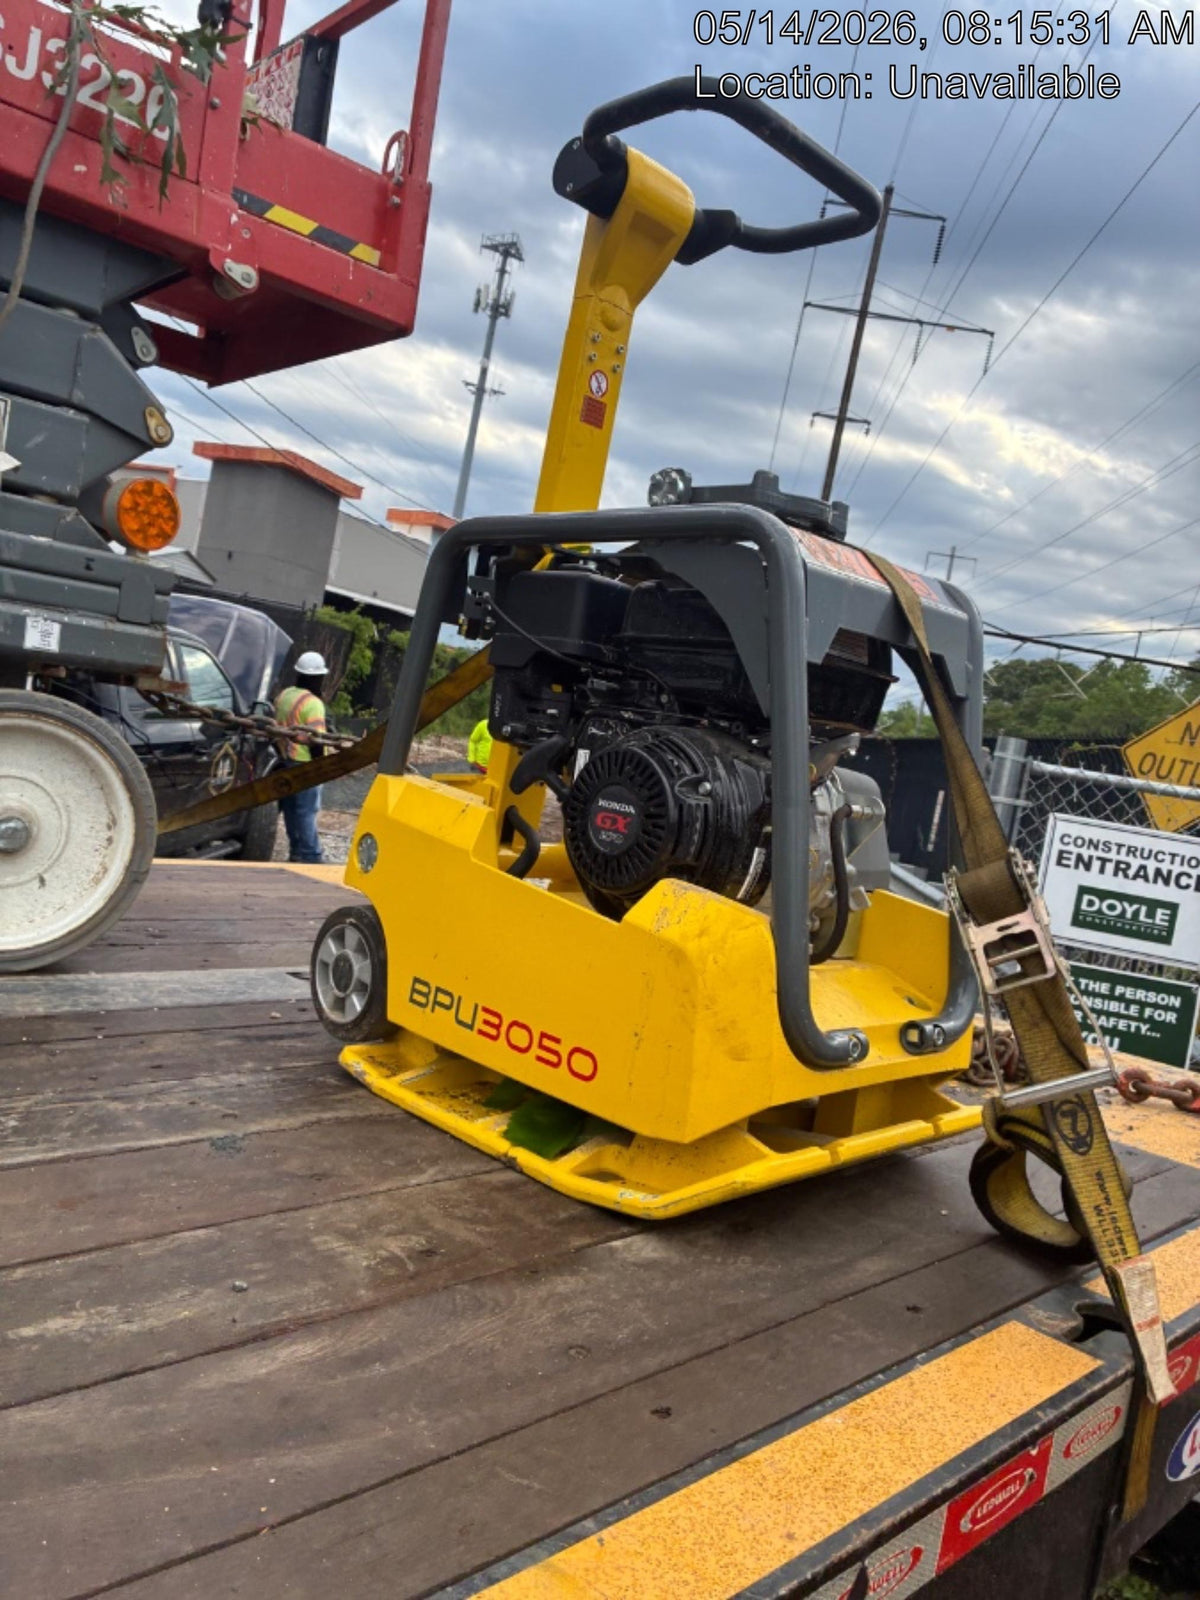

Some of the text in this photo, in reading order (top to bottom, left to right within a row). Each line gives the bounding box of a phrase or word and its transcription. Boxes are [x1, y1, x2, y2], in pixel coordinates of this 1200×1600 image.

[1179, 721, 1200, 746] N
[1137, 751, 1200, 786] OUTL
[597, 798, 636, 815] HONDA
[596, 811, 633, 835] GX
[1059, 833, 1200, 869] CONSTRUCTIO
[1055, 849, 1200, 892] ENTRANC
[1080, 894, 1172, 926] DOYLE
[1078, 977, 1111, 995] THE
[1114, 985, 1181, 1008] PERSON
[1070, 994, 1141, 1017] ONSIBLE
[1144, 1007, 1178, 1024] FOR
[408, 976, 598, 1082] BPU3050
